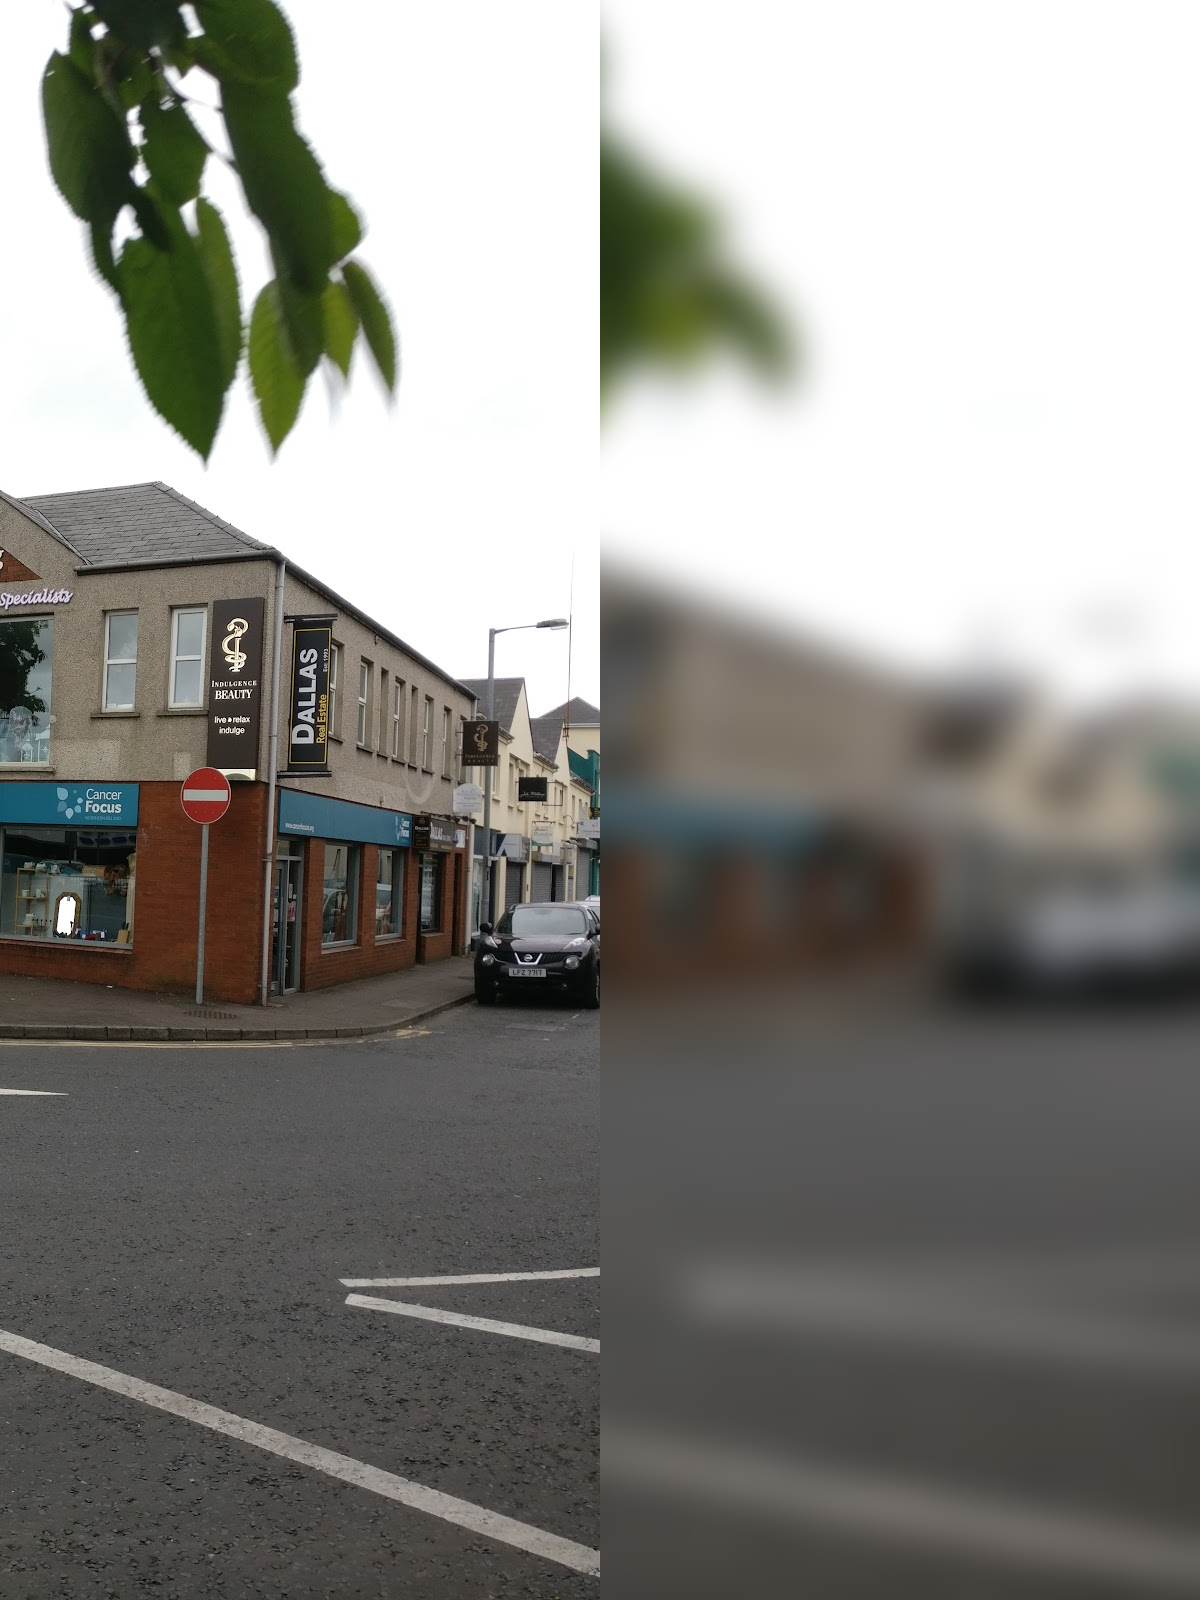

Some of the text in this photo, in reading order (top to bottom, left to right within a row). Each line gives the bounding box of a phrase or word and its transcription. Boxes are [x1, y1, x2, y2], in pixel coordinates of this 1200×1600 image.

[0, 588, 73, 610] Specialists
[212, 680, 257, 688] INDULGENCE
[215, 689, 253, 700] BEAUTY
[292, 648, 318, 745] DALLAS
[214, 715, 250, 724] live relax
[316, 693, 327, 744] Real Estate
[219, 726, 245, 735] indulge
[86, 788, 122, 800] Cancer
[85, 800, 122, 813] Focus
